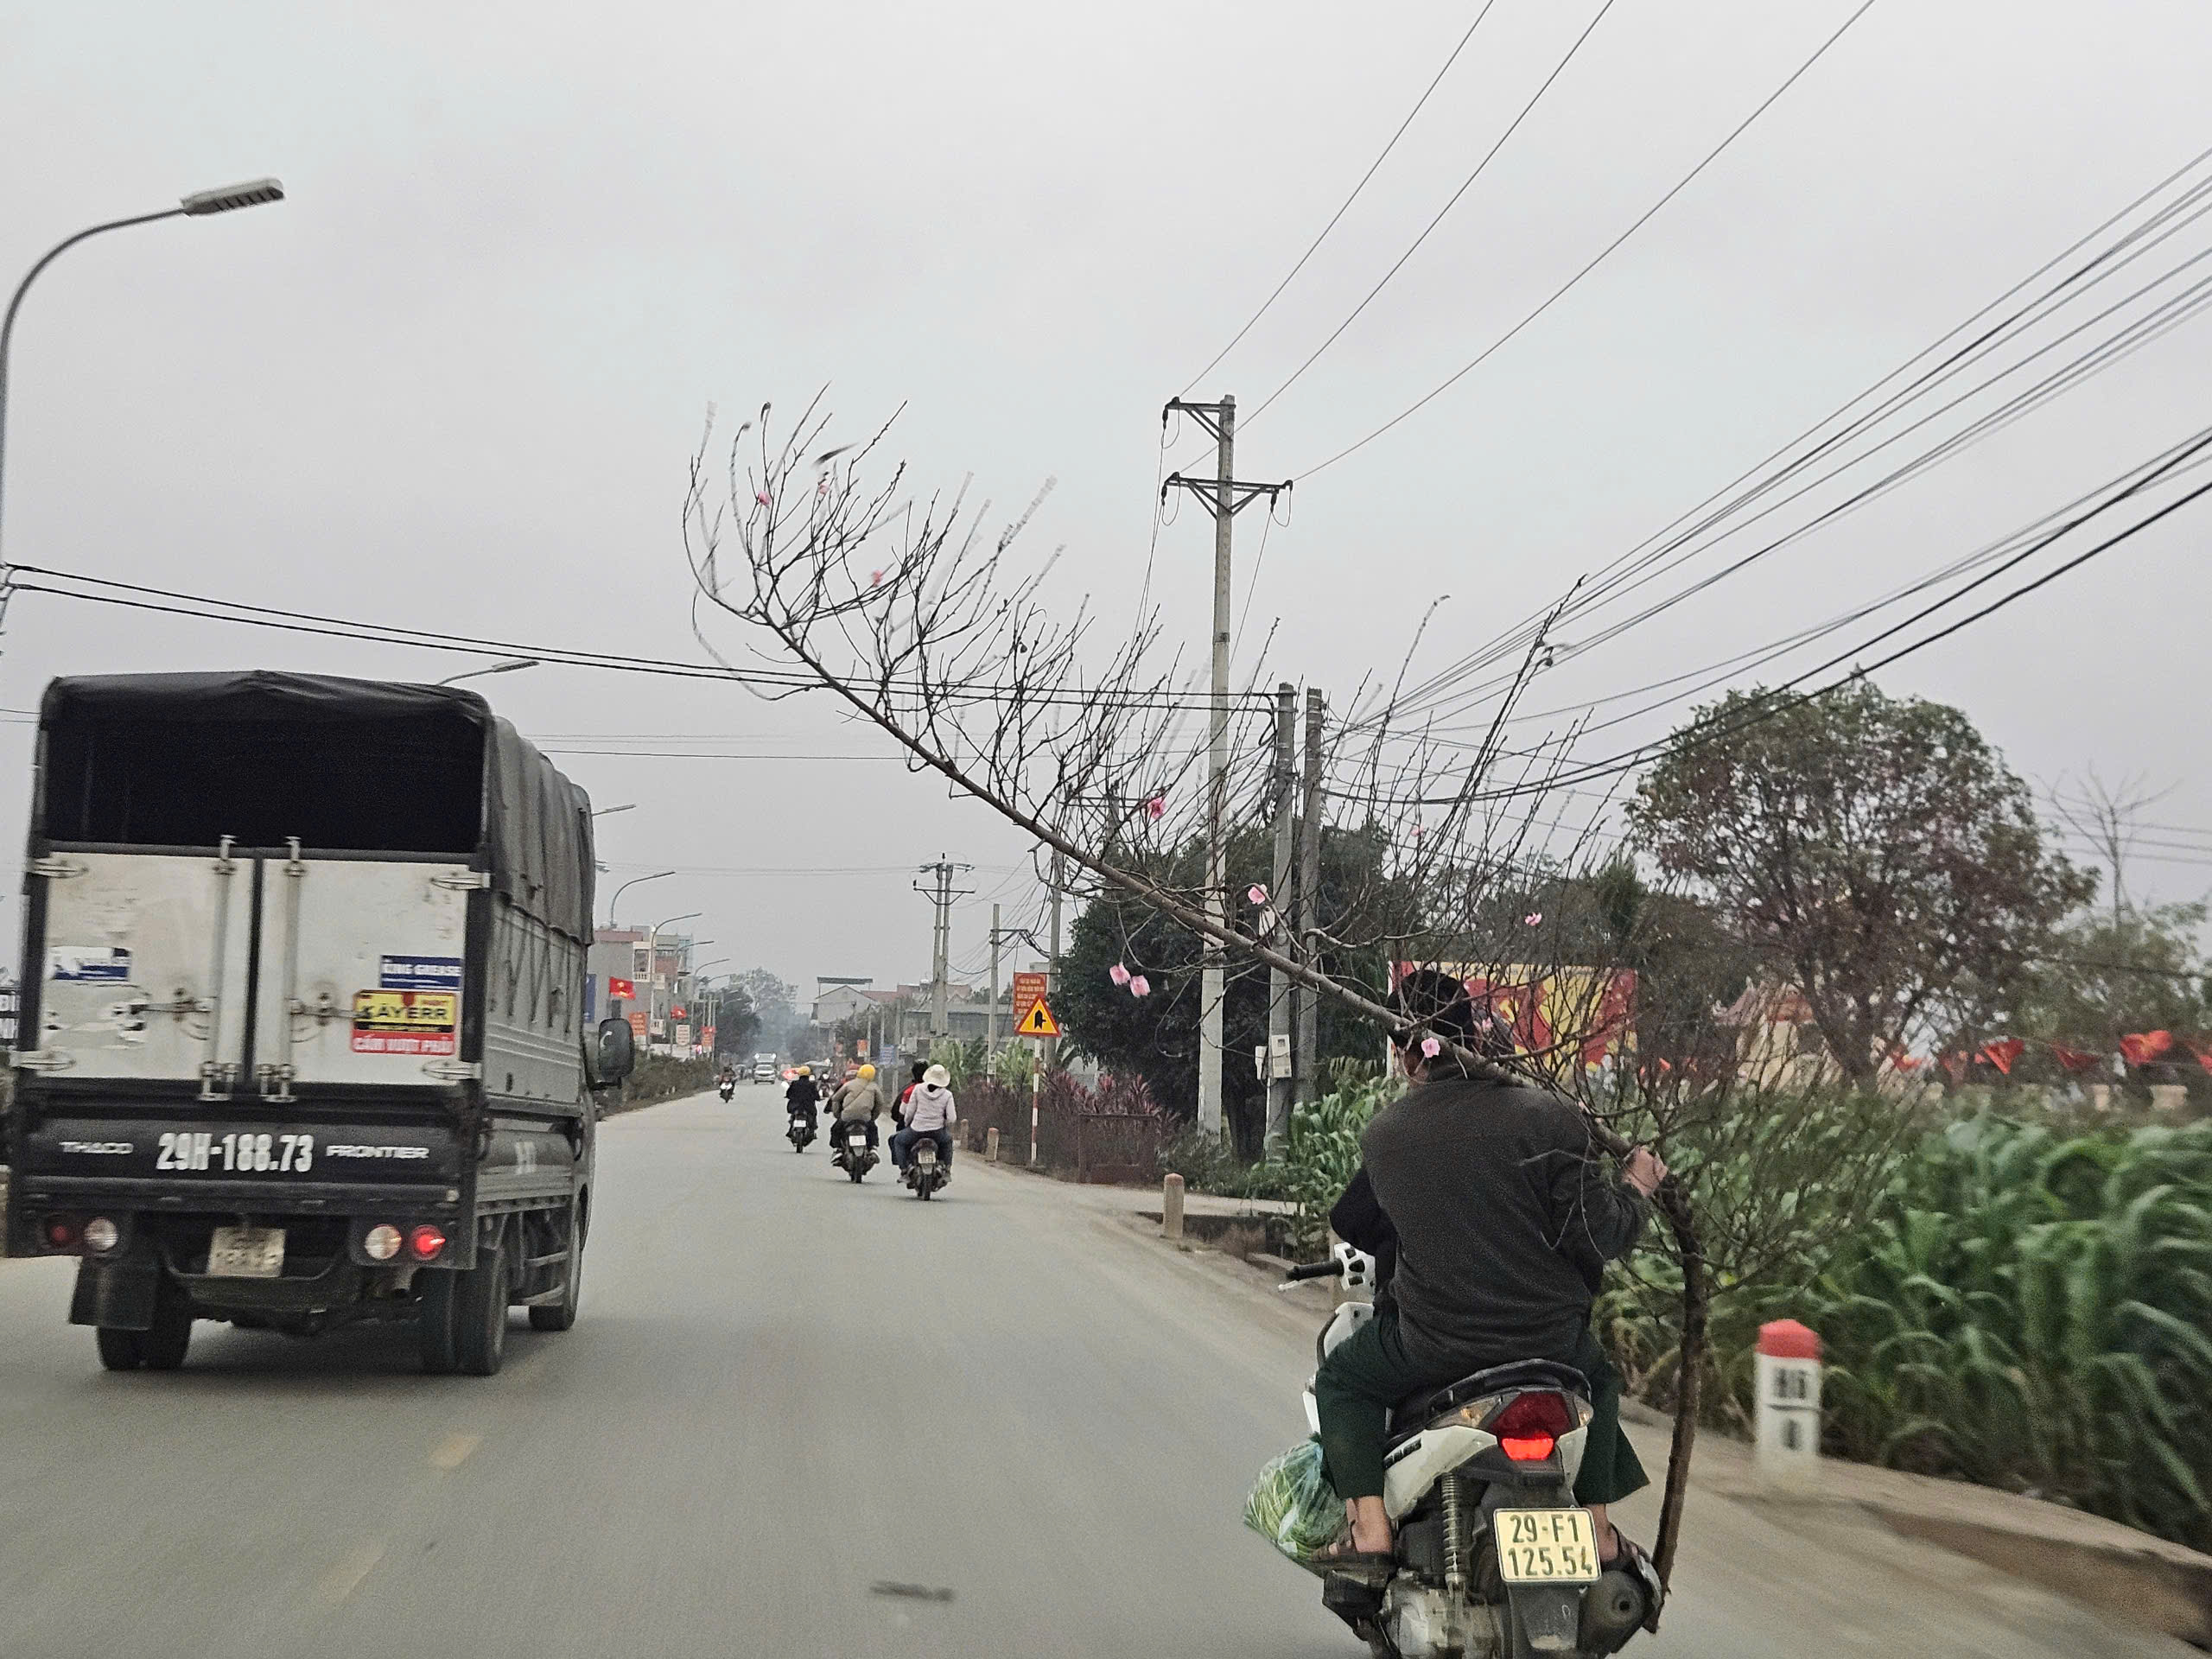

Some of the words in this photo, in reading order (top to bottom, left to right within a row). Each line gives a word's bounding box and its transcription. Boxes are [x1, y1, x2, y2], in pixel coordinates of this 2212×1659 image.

[325, 1144, 430, 1160] FRONTIER
[1509, 1513, 1580, 1543] 29-F1
[1507, 1545, 1593, 1577] 125.54
